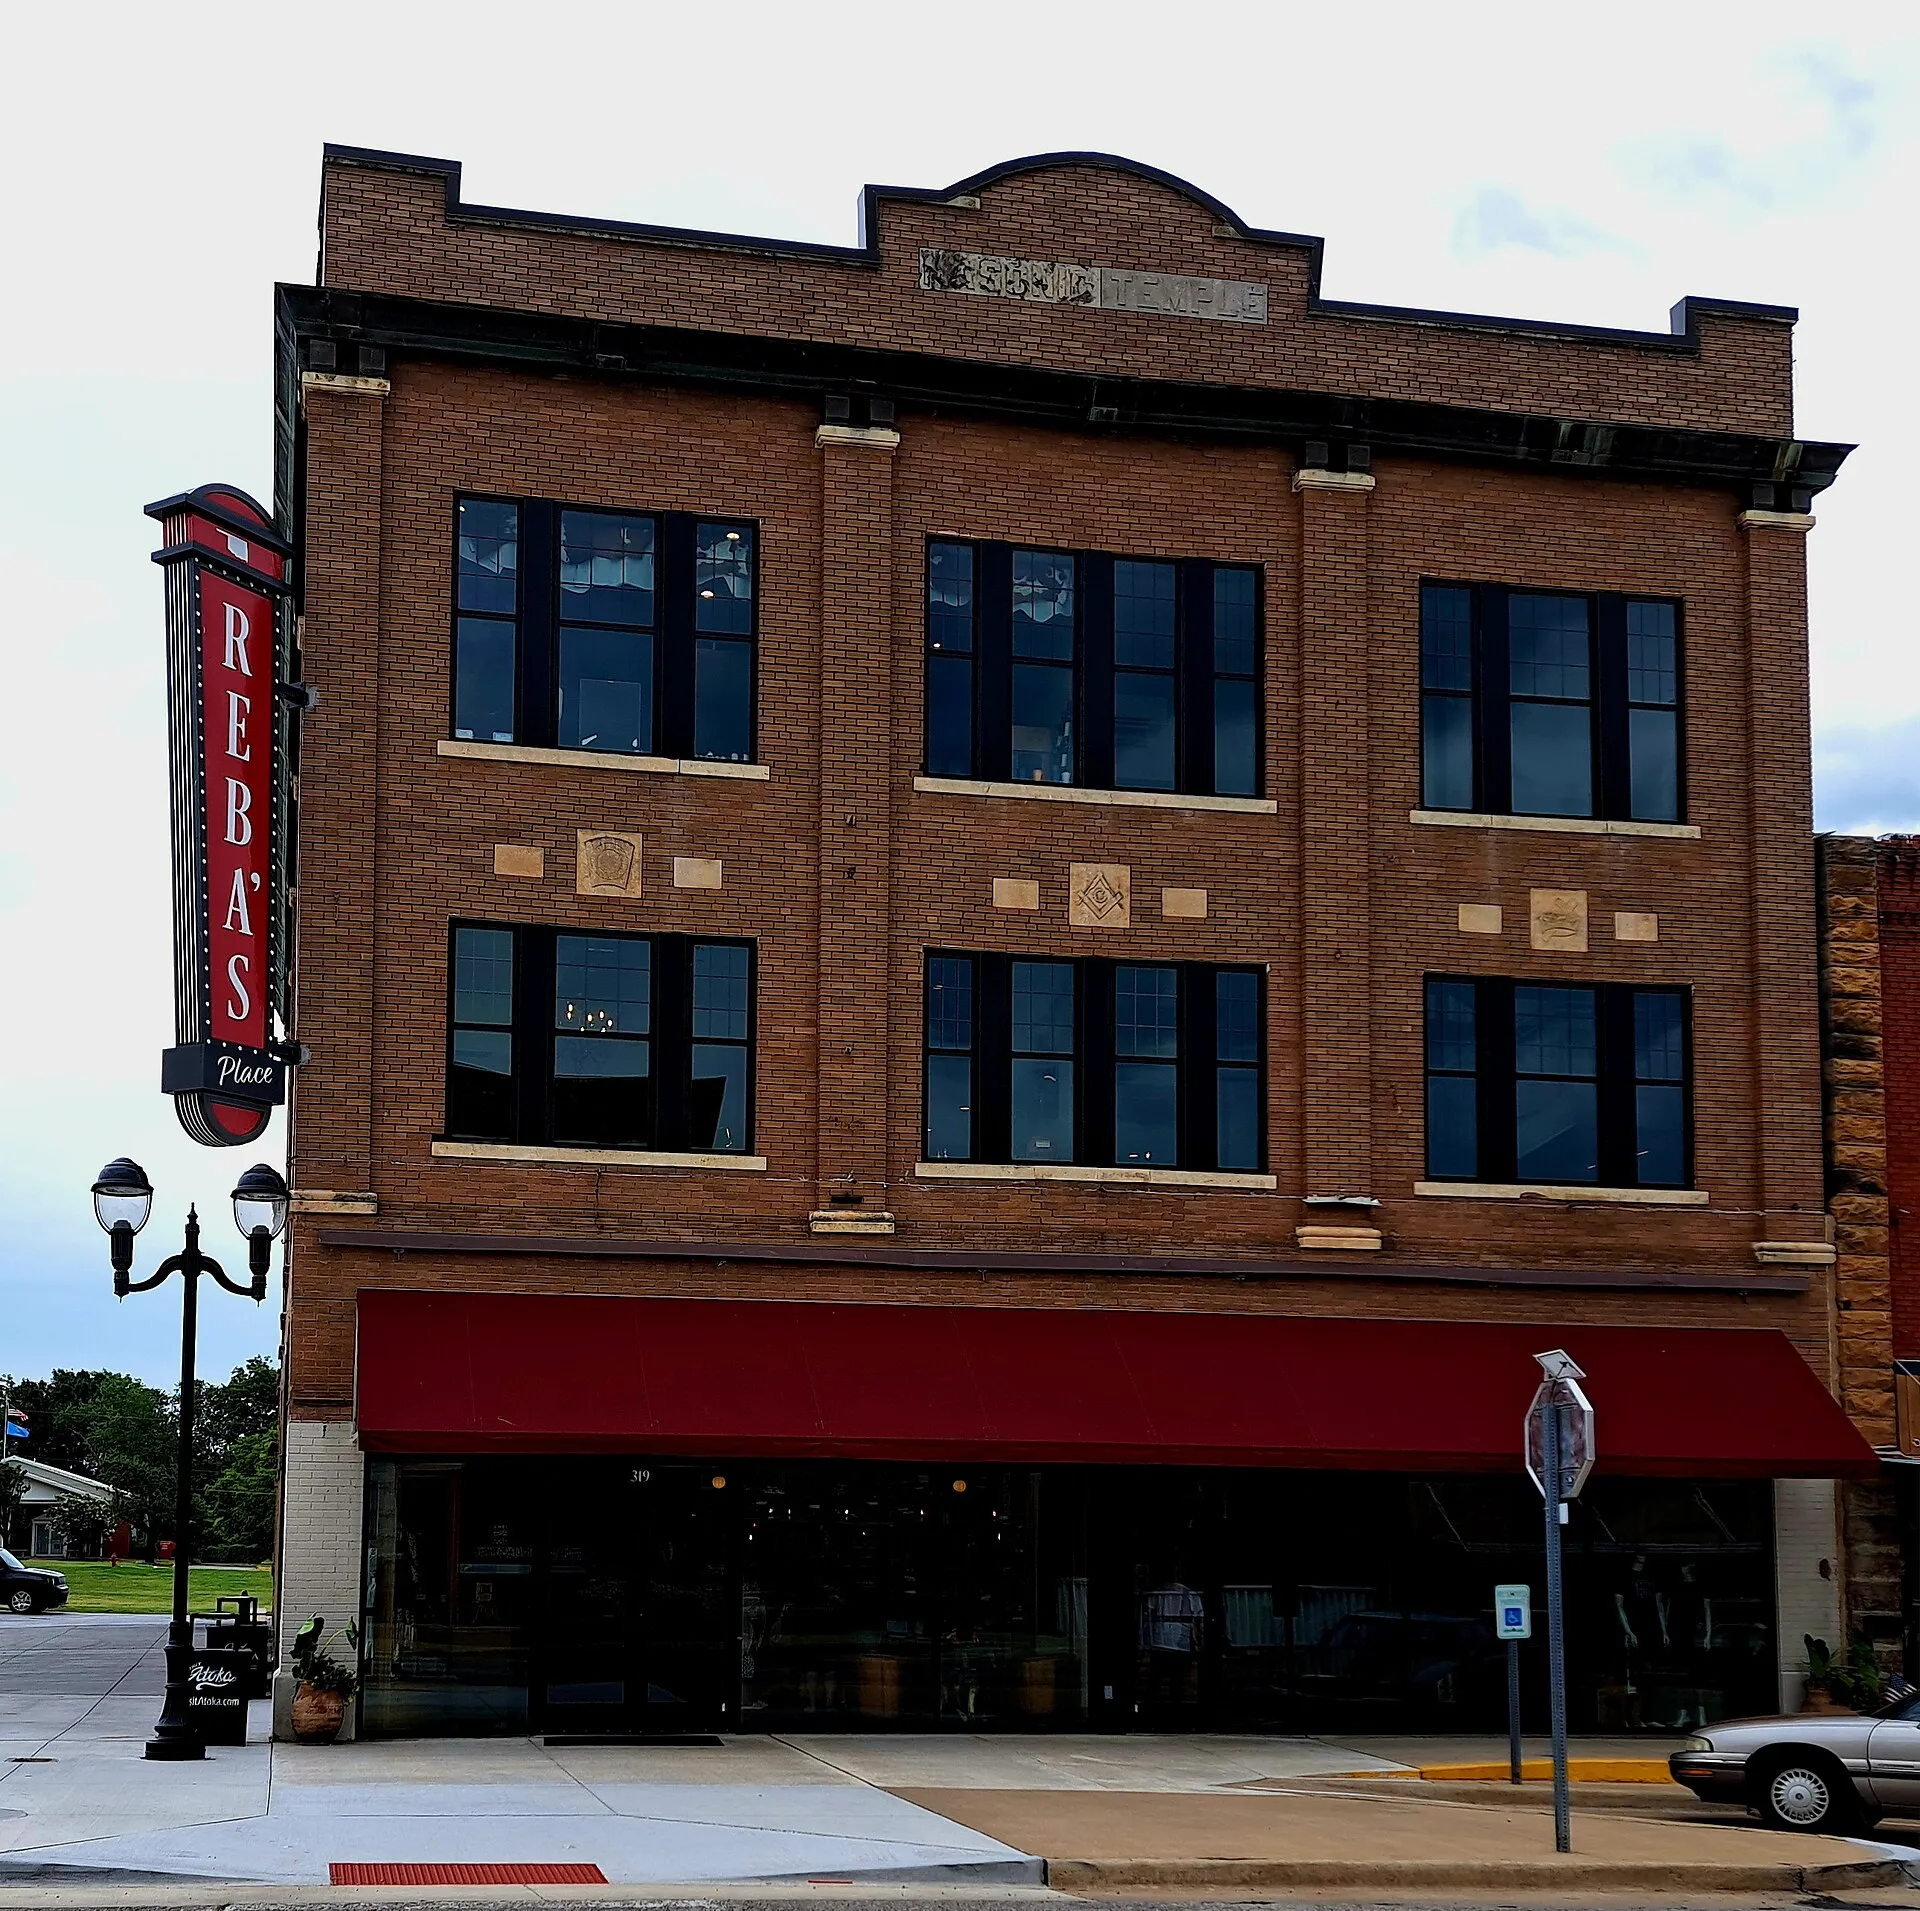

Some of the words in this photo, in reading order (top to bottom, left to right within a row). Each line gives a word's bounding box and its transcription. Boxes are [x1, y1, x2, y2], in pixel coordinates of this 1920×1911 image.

[1111, 276, 1264, 320] TEMPLE
[221, 602, 261, 1020] REBA'S
[217, 1055, 273, 1086] Place
[630, 1470, 650, 1482] 319
[188, 1665, 237, 1685] Atoka
[188, 1696, 240, 1707] sitAtoka.com
